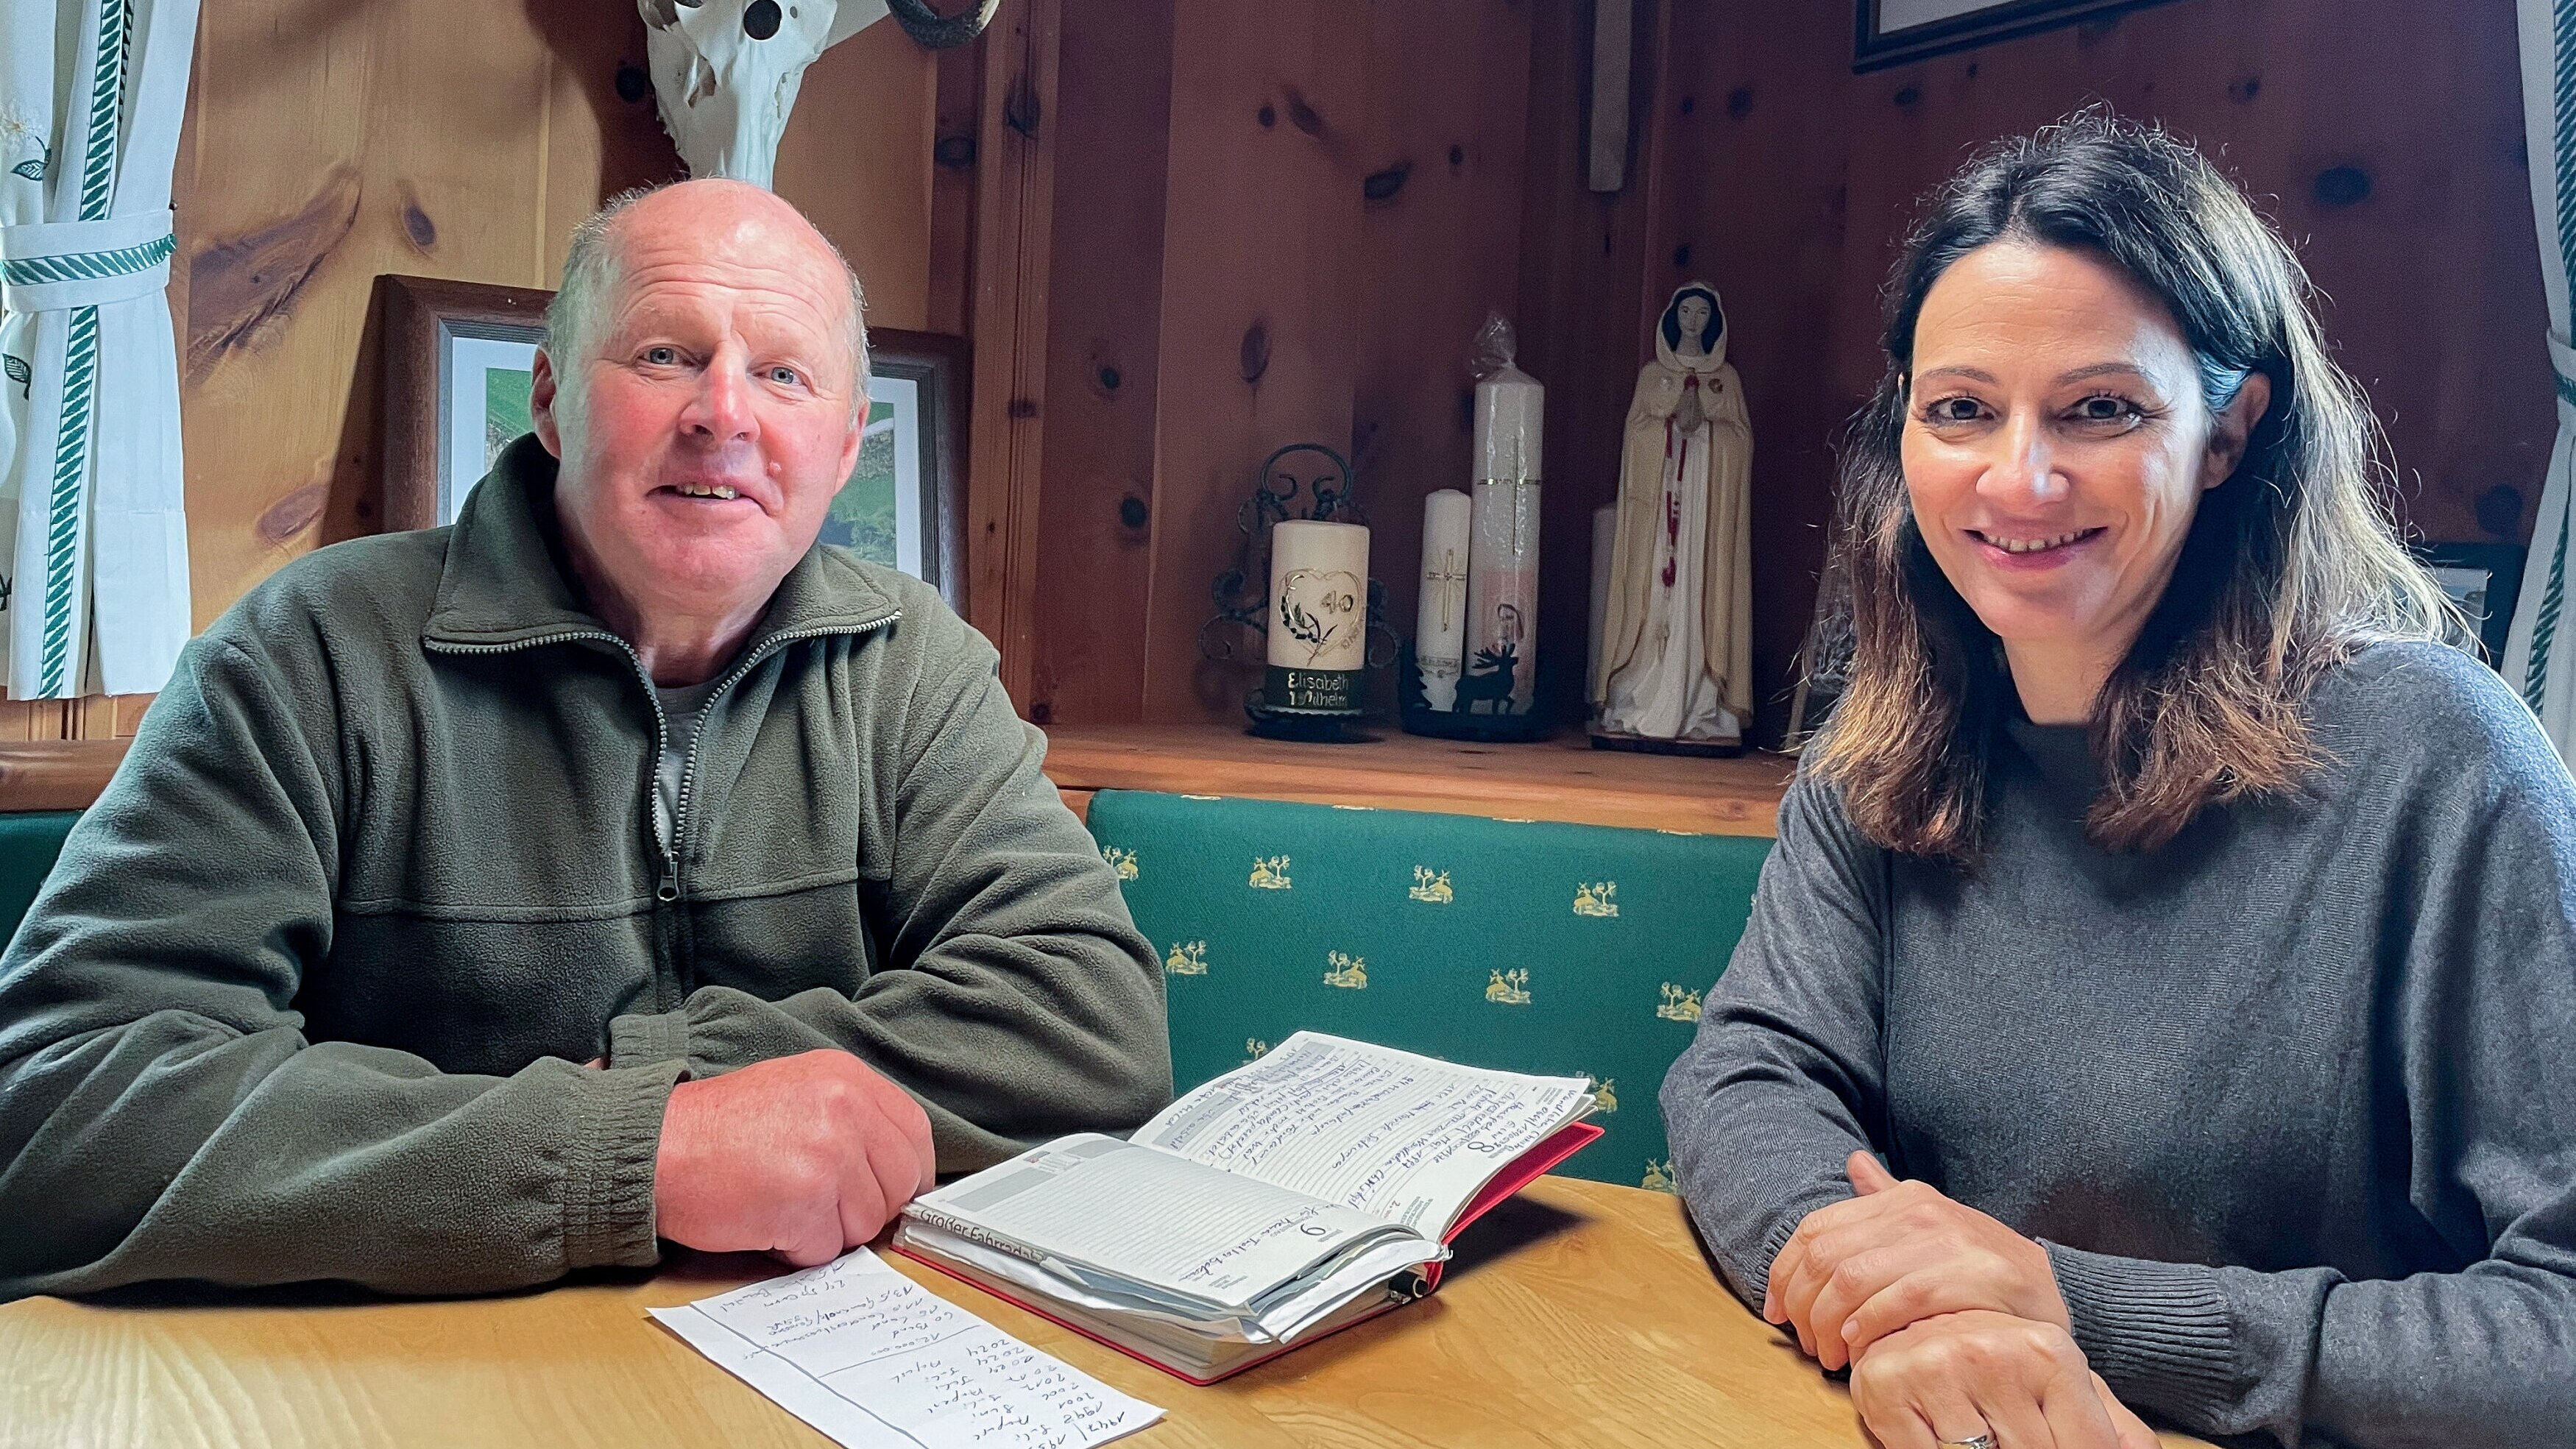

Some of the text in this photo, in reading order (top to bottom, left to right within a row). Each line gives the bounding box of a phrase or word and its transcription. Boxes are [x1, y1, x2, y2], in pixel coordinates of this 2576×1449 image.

[1320, 591, 1354, 614] 40
[1288, 672, 1349, 691] Elisabeth
[1468, 1141, 1494, 1153] 8
[920, 1209, 969, 1236] Großer
[1300, 1223, 1326, 1236] 9
[966, 1339, 1010, 1357] 2024
[1058, 1392, 1095, 1410] 2001
